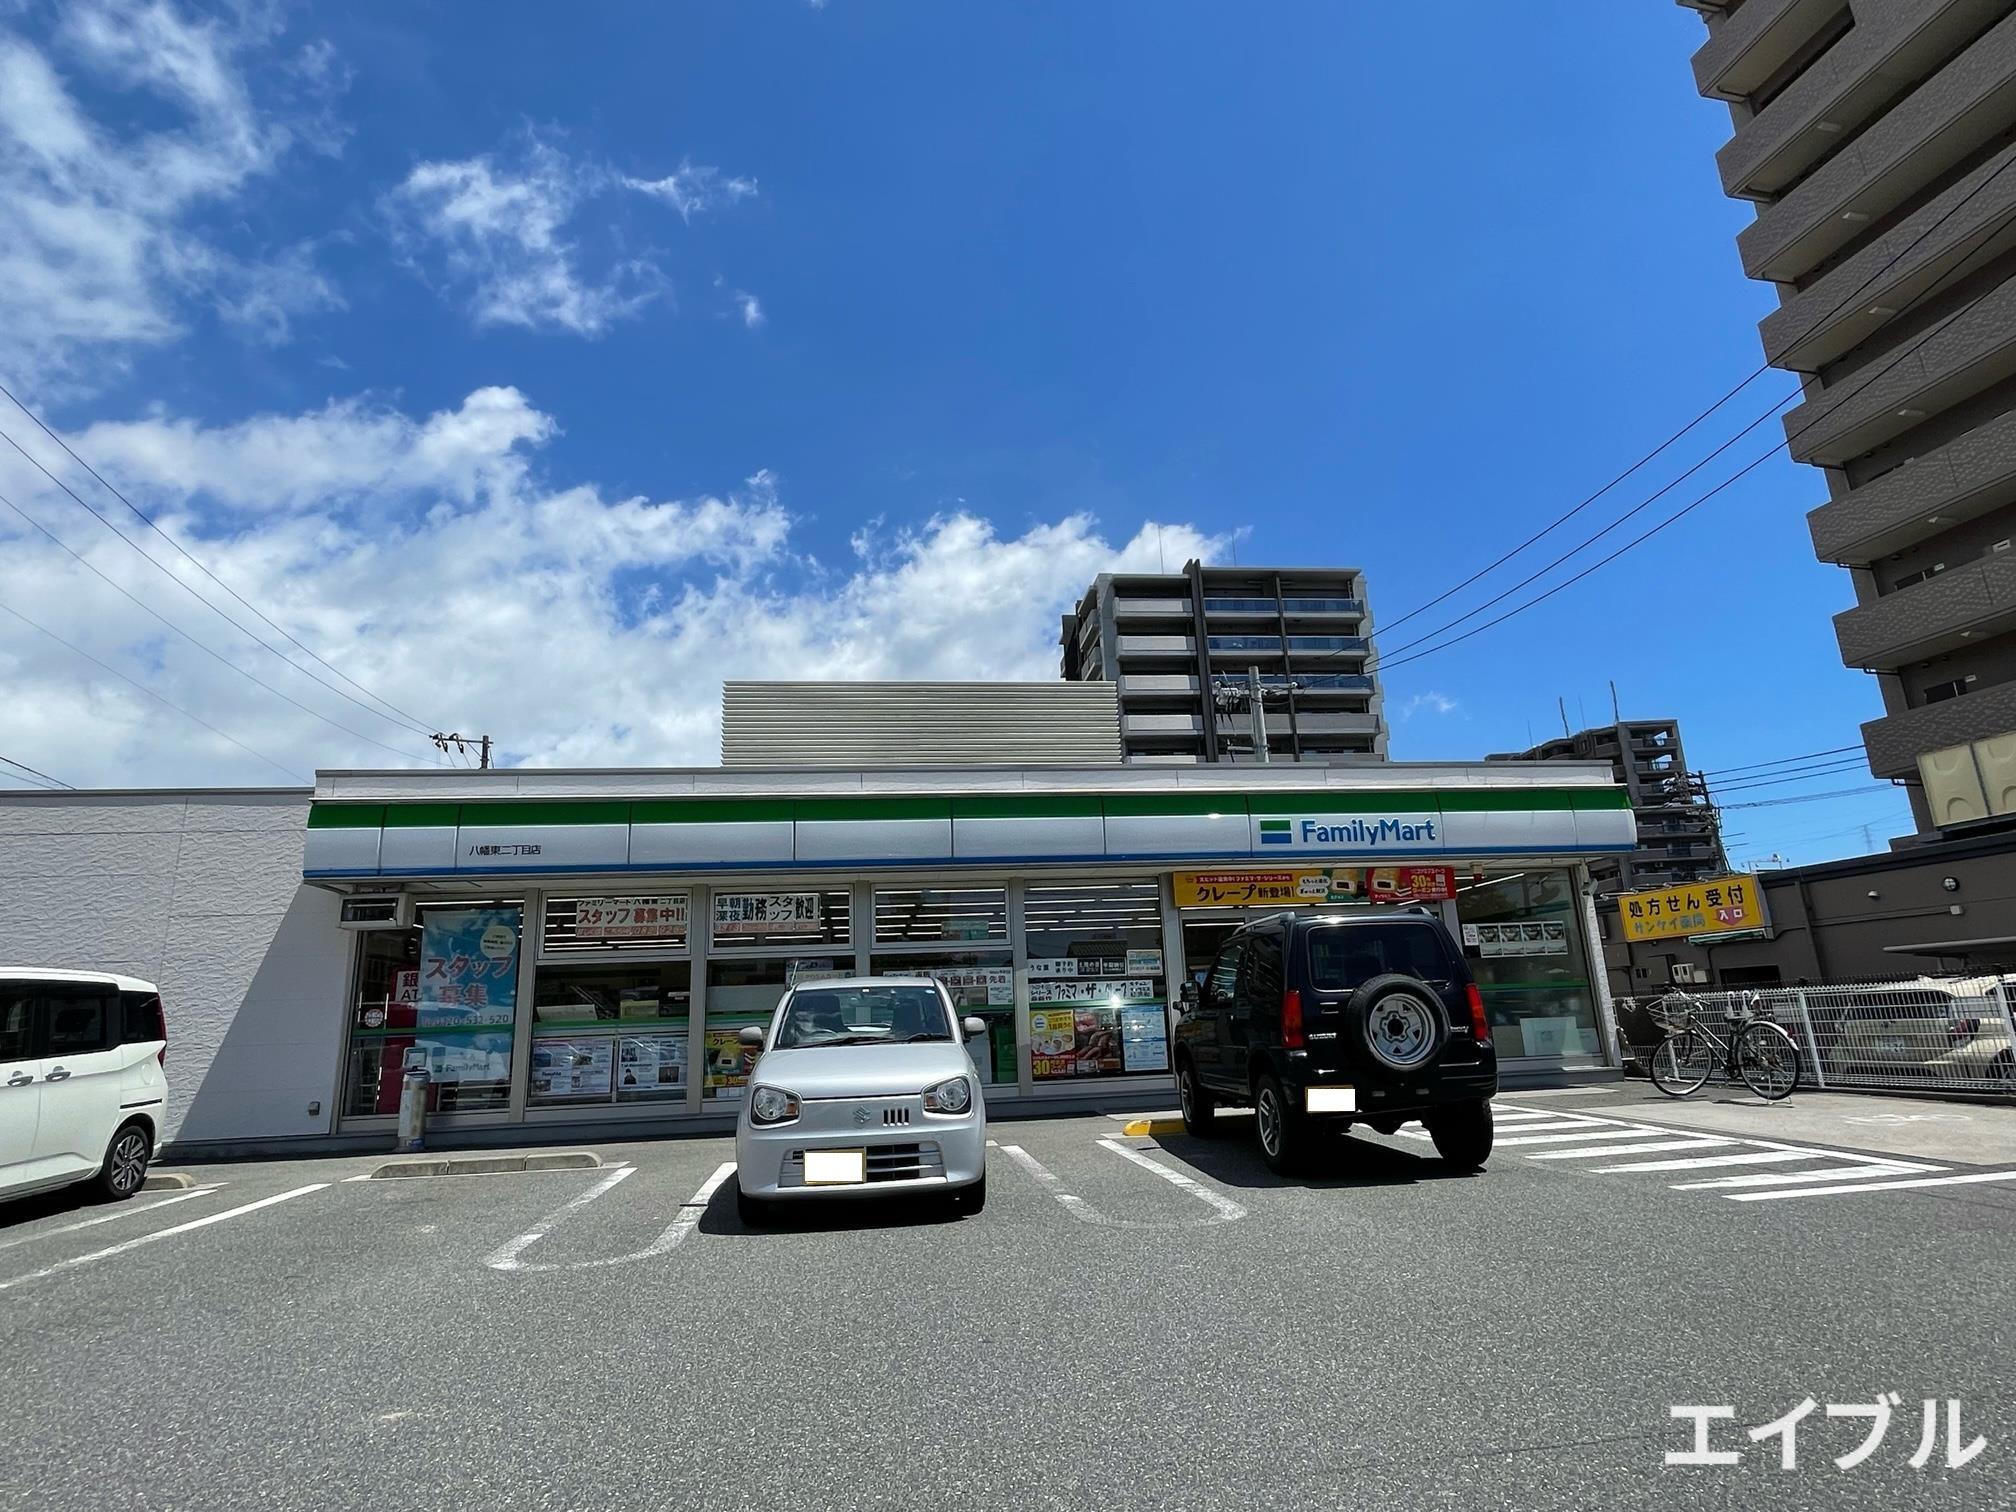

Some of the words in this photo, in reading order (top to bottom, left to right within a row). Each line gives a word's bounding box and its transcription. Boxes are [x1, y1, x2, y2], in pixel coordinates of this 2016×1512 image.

[1301, 818, 1435, 845] FamilyMart
[469, 844, 541, 856] 八幡東二丁目店
[1629, 884, 1744, 918] 処方せん受付
[1719, 908, 1743, 920] 入口
[425, 953, 513, 979] スタッフ
[402, 972, 418, 987] 銀
[401, 989, 418, 1000] AT
[439, 983, 488, 1007] 募集
[1033, 1060, 1050, 1075] 30
